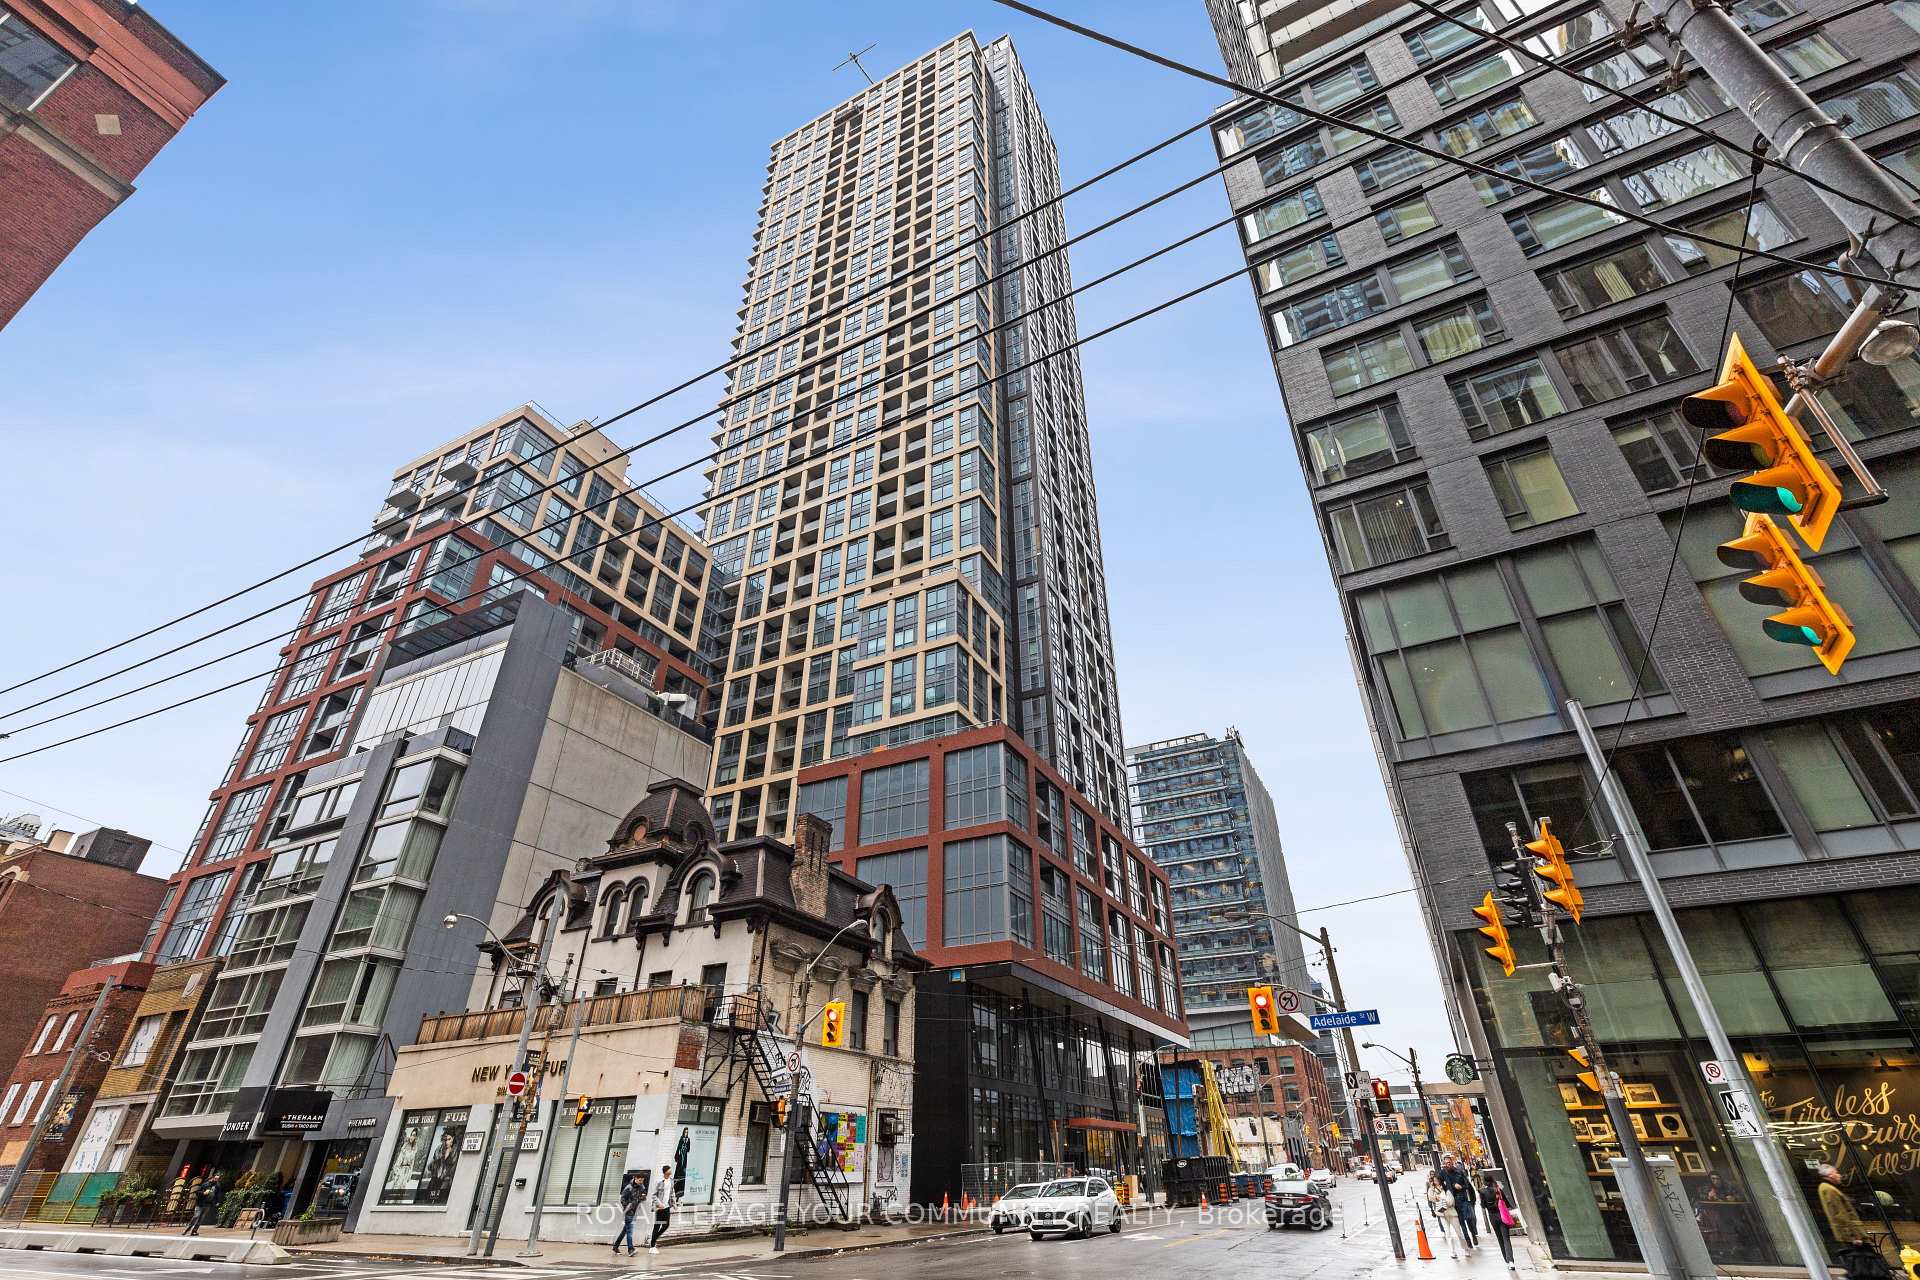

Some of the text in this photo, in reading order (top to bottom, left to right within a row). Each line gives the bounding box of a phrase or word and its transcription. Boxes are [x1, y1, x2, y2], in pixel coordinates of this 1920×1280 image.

[1314, 1014, 1357, 1027] Adelaide
[1366, 1012, 1376, 1023] W
[472, 1065, 500, 1082] NEW
[702, 1105, 720, 1113] FUR
[407, 1112, 468, 1125] NEW YORK FUR
